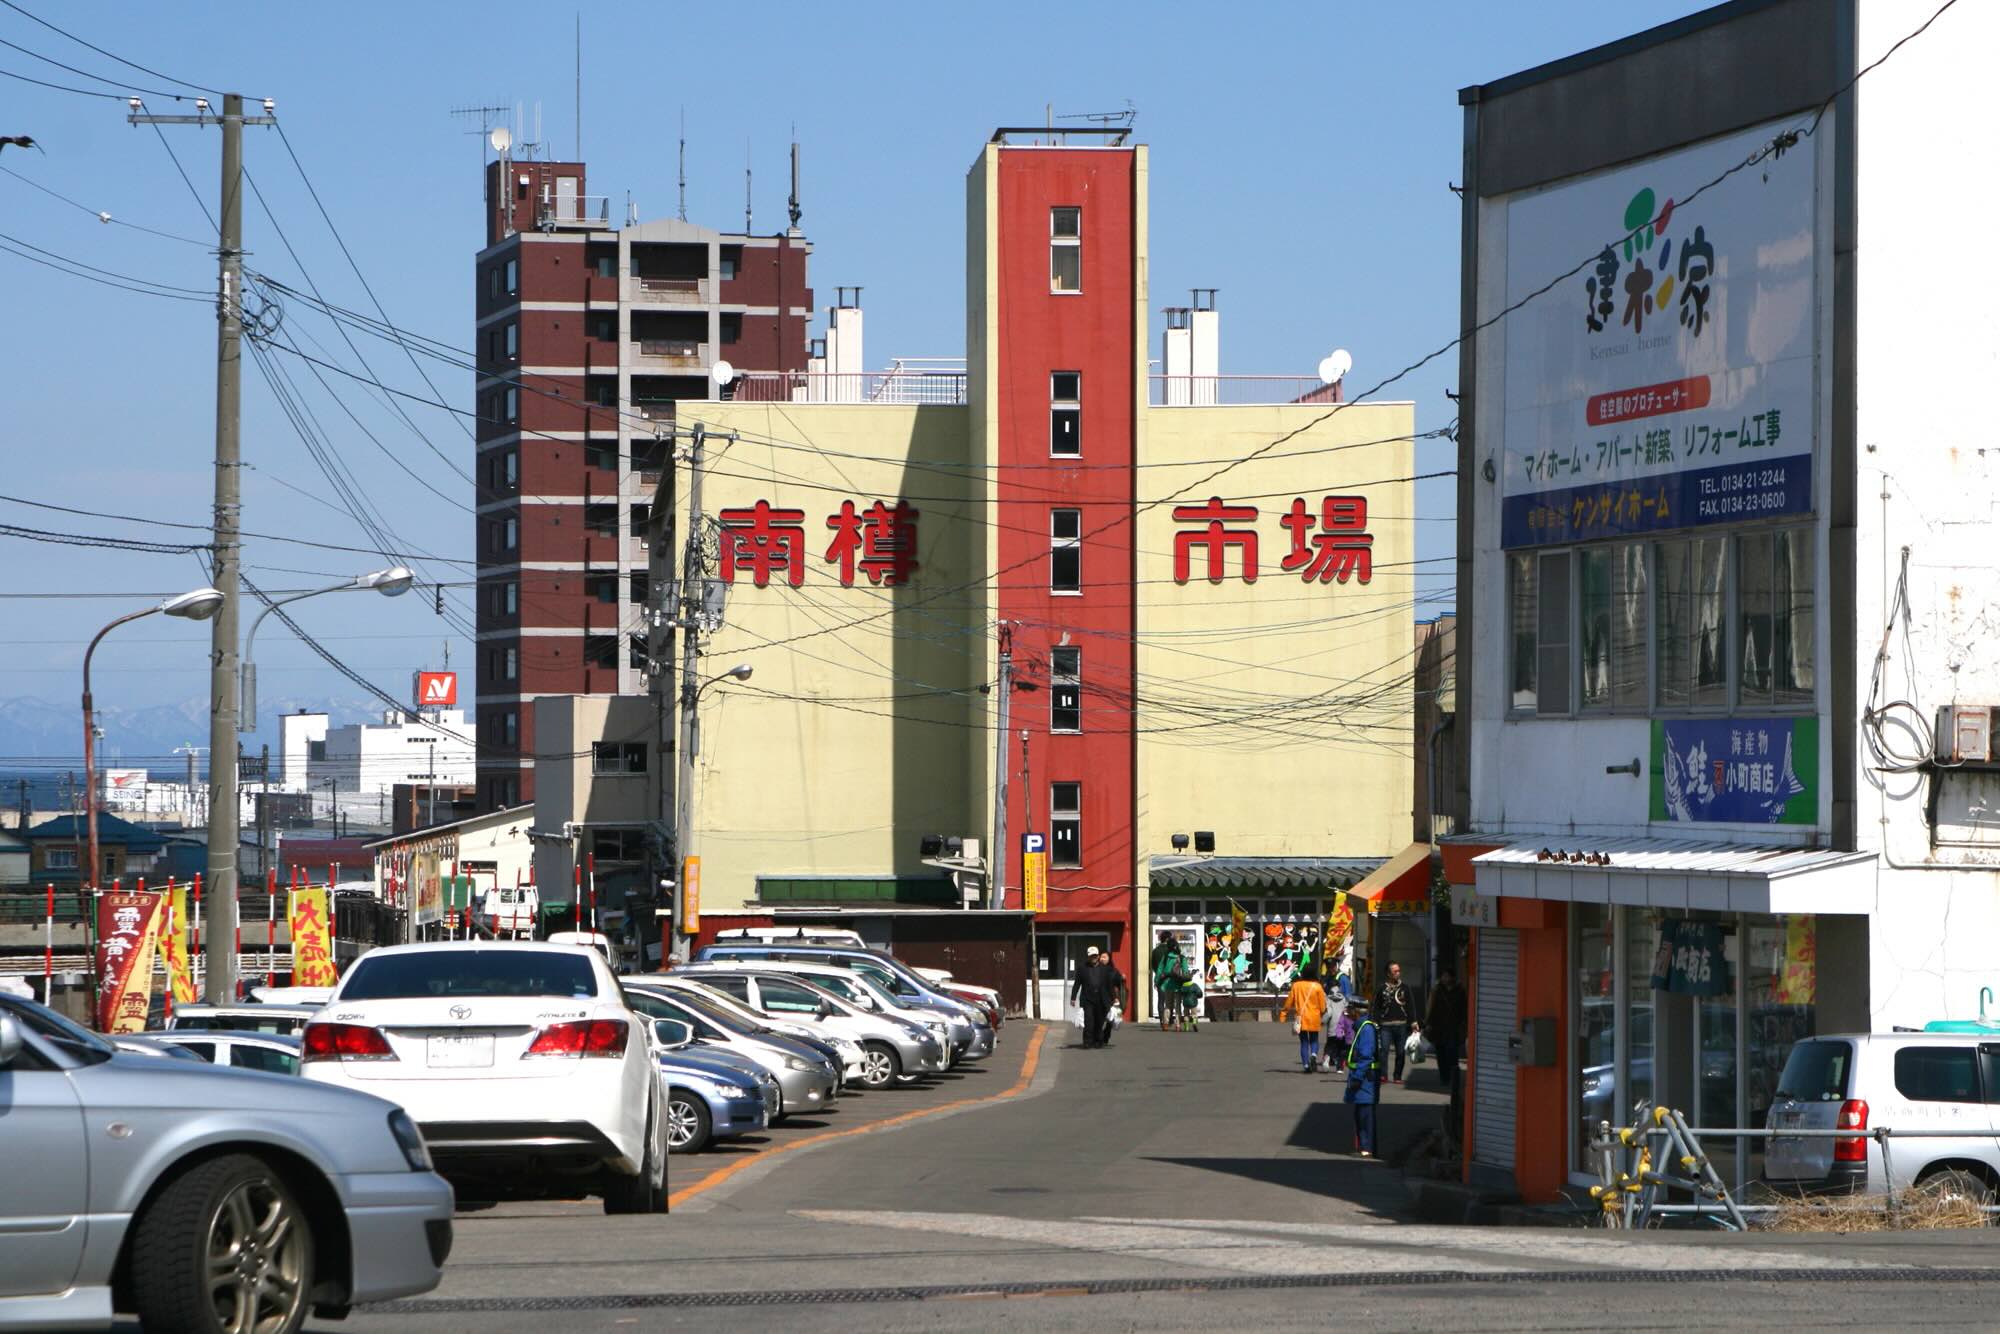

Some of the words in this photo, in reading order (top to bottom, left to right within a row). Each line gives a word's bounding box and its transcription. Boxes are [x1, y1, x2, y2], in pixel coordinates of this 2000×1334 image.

[1638, 335, 1672, 351] home
[1600, 387, 1689, 419] 住空間のプロデューサー
[1685, 409, 1781, 457] リフォーム工事
[1573, 486, 1670, 529] ケンサイホーム
[719, 499, 919, 587] 南樽
[1172, 496, 1375, 584] 市場
[1731, 729, 1768, 756] 海産物
[1726, 762, 1774, 795] 小町商店
[1026, 834, 1043, 853] P
